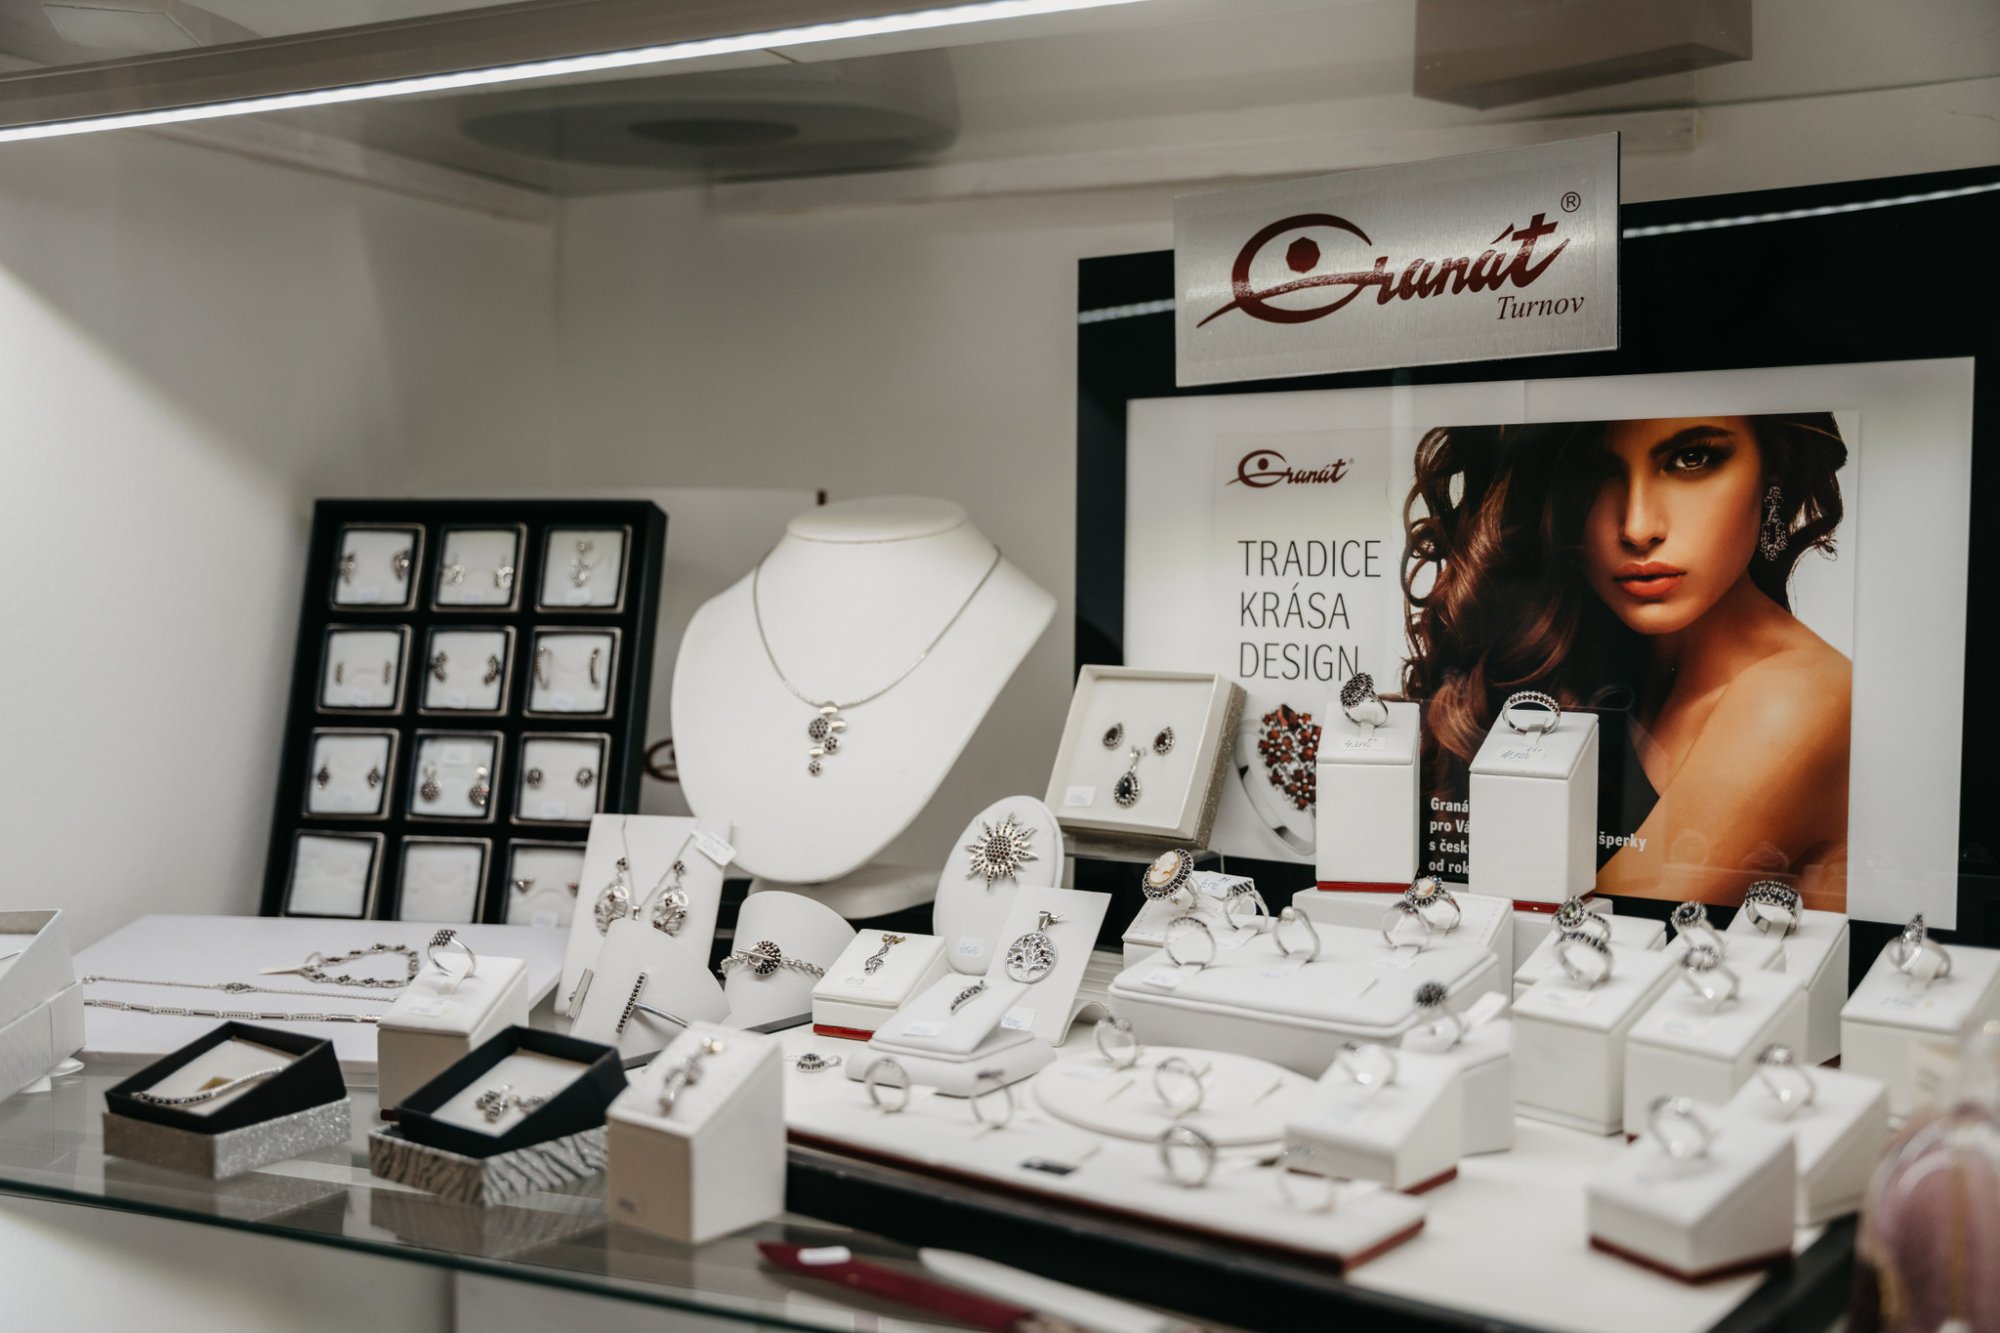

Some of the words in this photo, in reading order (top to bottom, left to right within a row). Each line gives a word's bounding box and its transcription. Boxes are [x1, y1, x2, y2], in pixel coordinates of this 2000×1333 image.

[1497, 295, 1585, 321] Turnov
[1237, 540, 1382, 578] TRADICE
[1240, 582, 1351, 630] KRÁSA
[1239, 642, 1359, 683] DESIGN
[1430, 796, 1469, 813] Graná
[1428, 840, 1436, 852] s
[1439, 838, 1469, 854] česk
[1429, 820, 1452, 834] pro
[1455, 819, 1470, 834] Vá
[1598, 831, 1647, 852] šperky
[1428, 858, 1445, 872] od
[1448, 860, 1469, 875] rok
